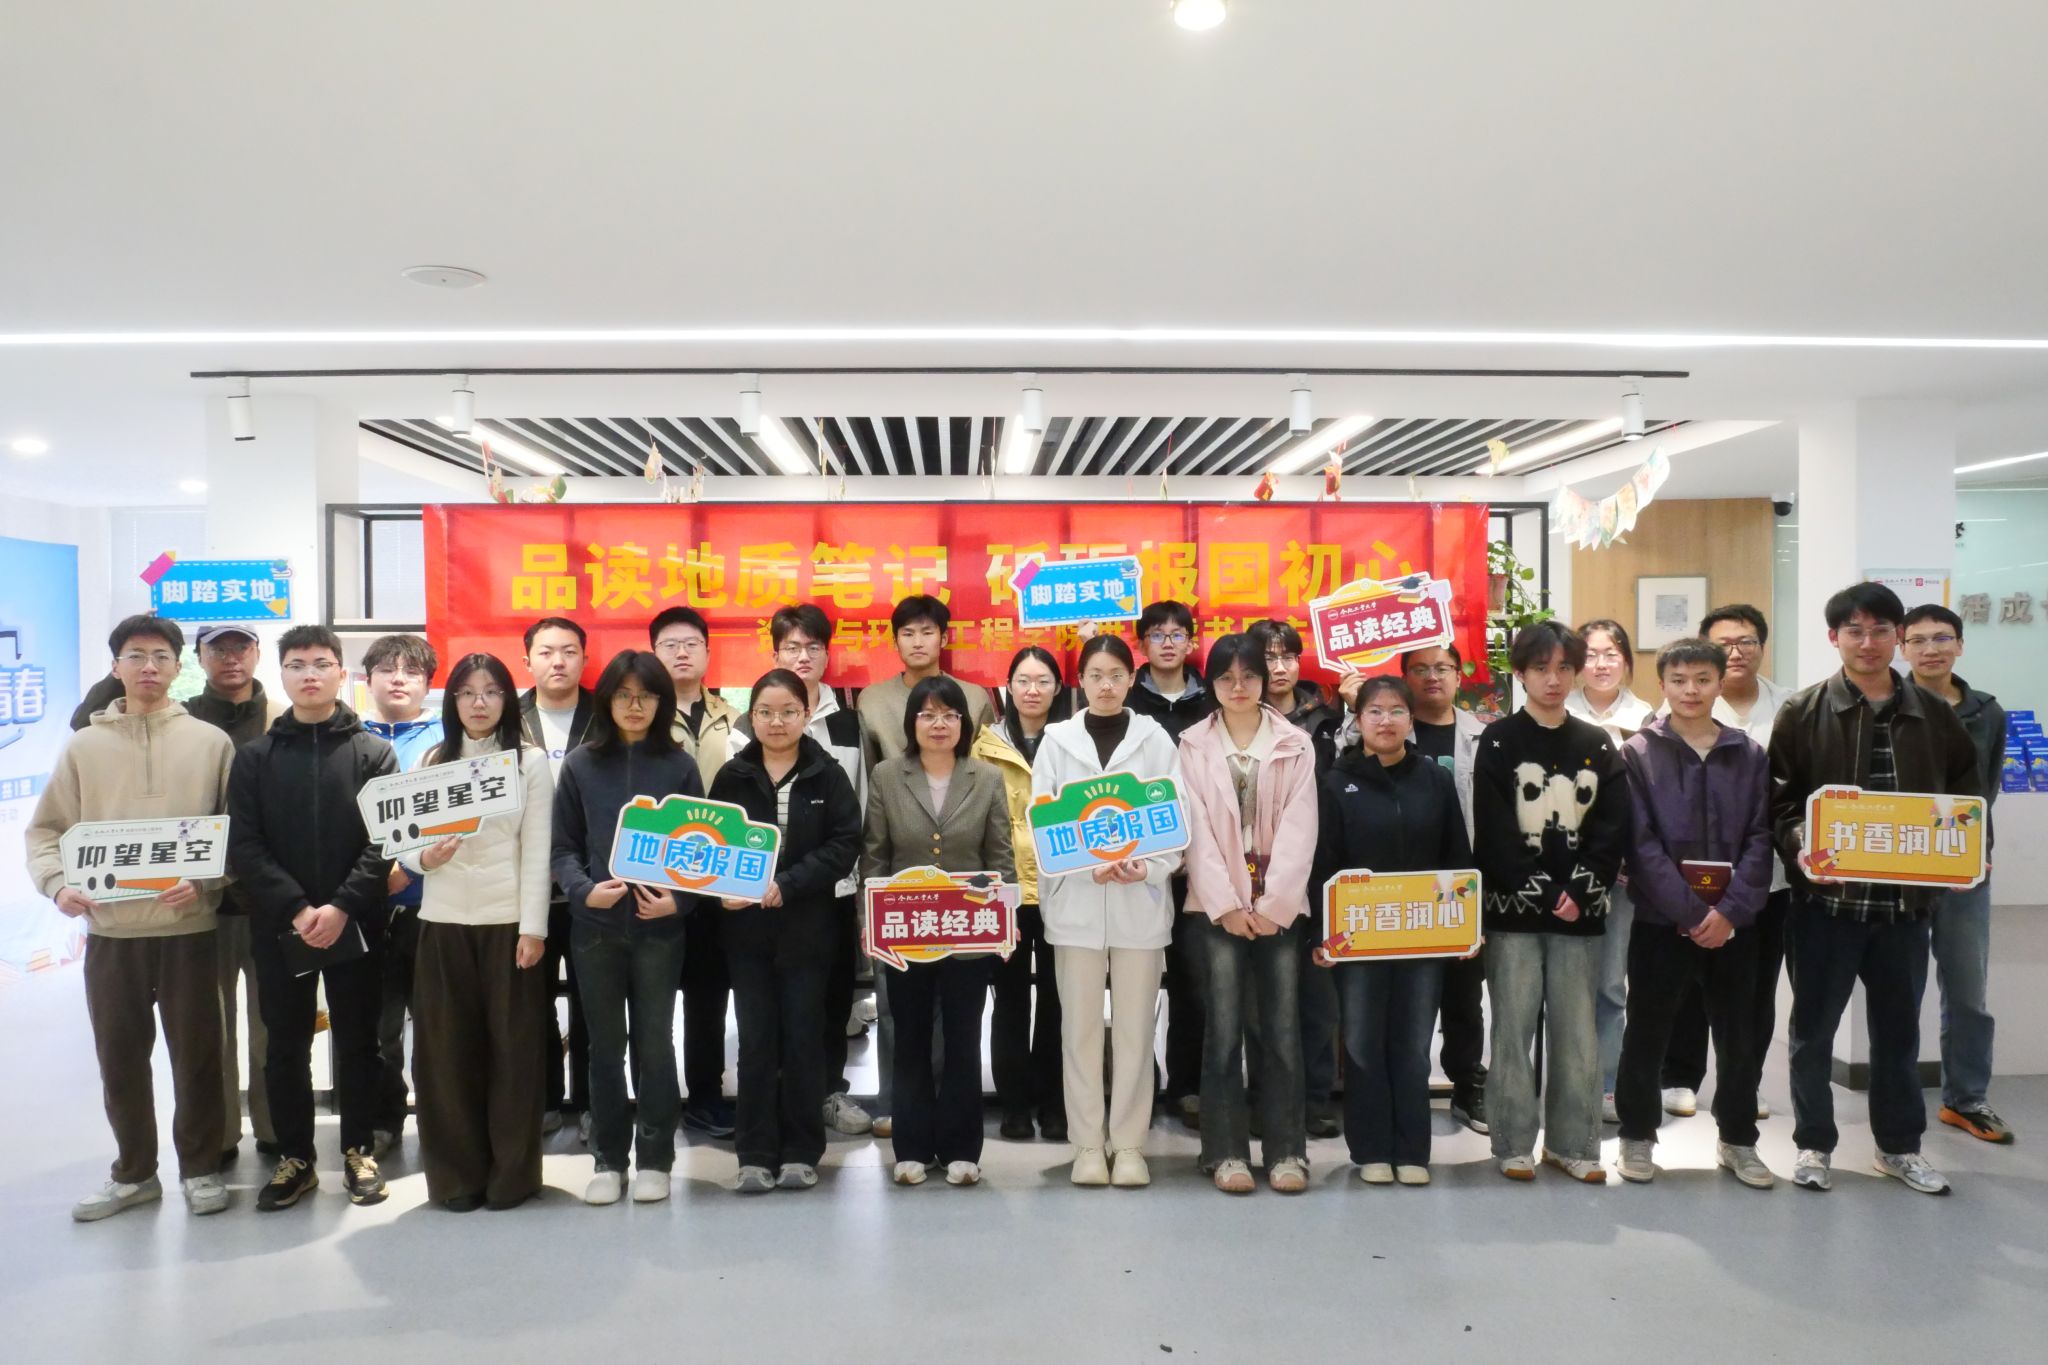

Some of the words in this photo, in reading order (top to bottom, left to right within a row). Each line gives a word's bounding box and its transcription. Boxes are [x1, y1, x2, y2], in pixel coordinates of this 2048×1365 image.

[162, 579, 276, 604] 脚踏实地
[512, 541, 950, 609] 品读地质笔记
[1030, 578, 1126, 606] 脚踏实地
[1329, 605, 1437, 652] 品读经典
[376, 775, 507, 824] 仰望星空
[1046, 803, 1179, 857] 地质报国
[1826, 820, 1968, 857] 书香润心
[76, 839, 213, 869] 仰望星空
[626, 832, 768, 882] 地质报国
[881, 908, 1000, 939] 品读经典
[1343, 900, 1466, 932] 书香润心
